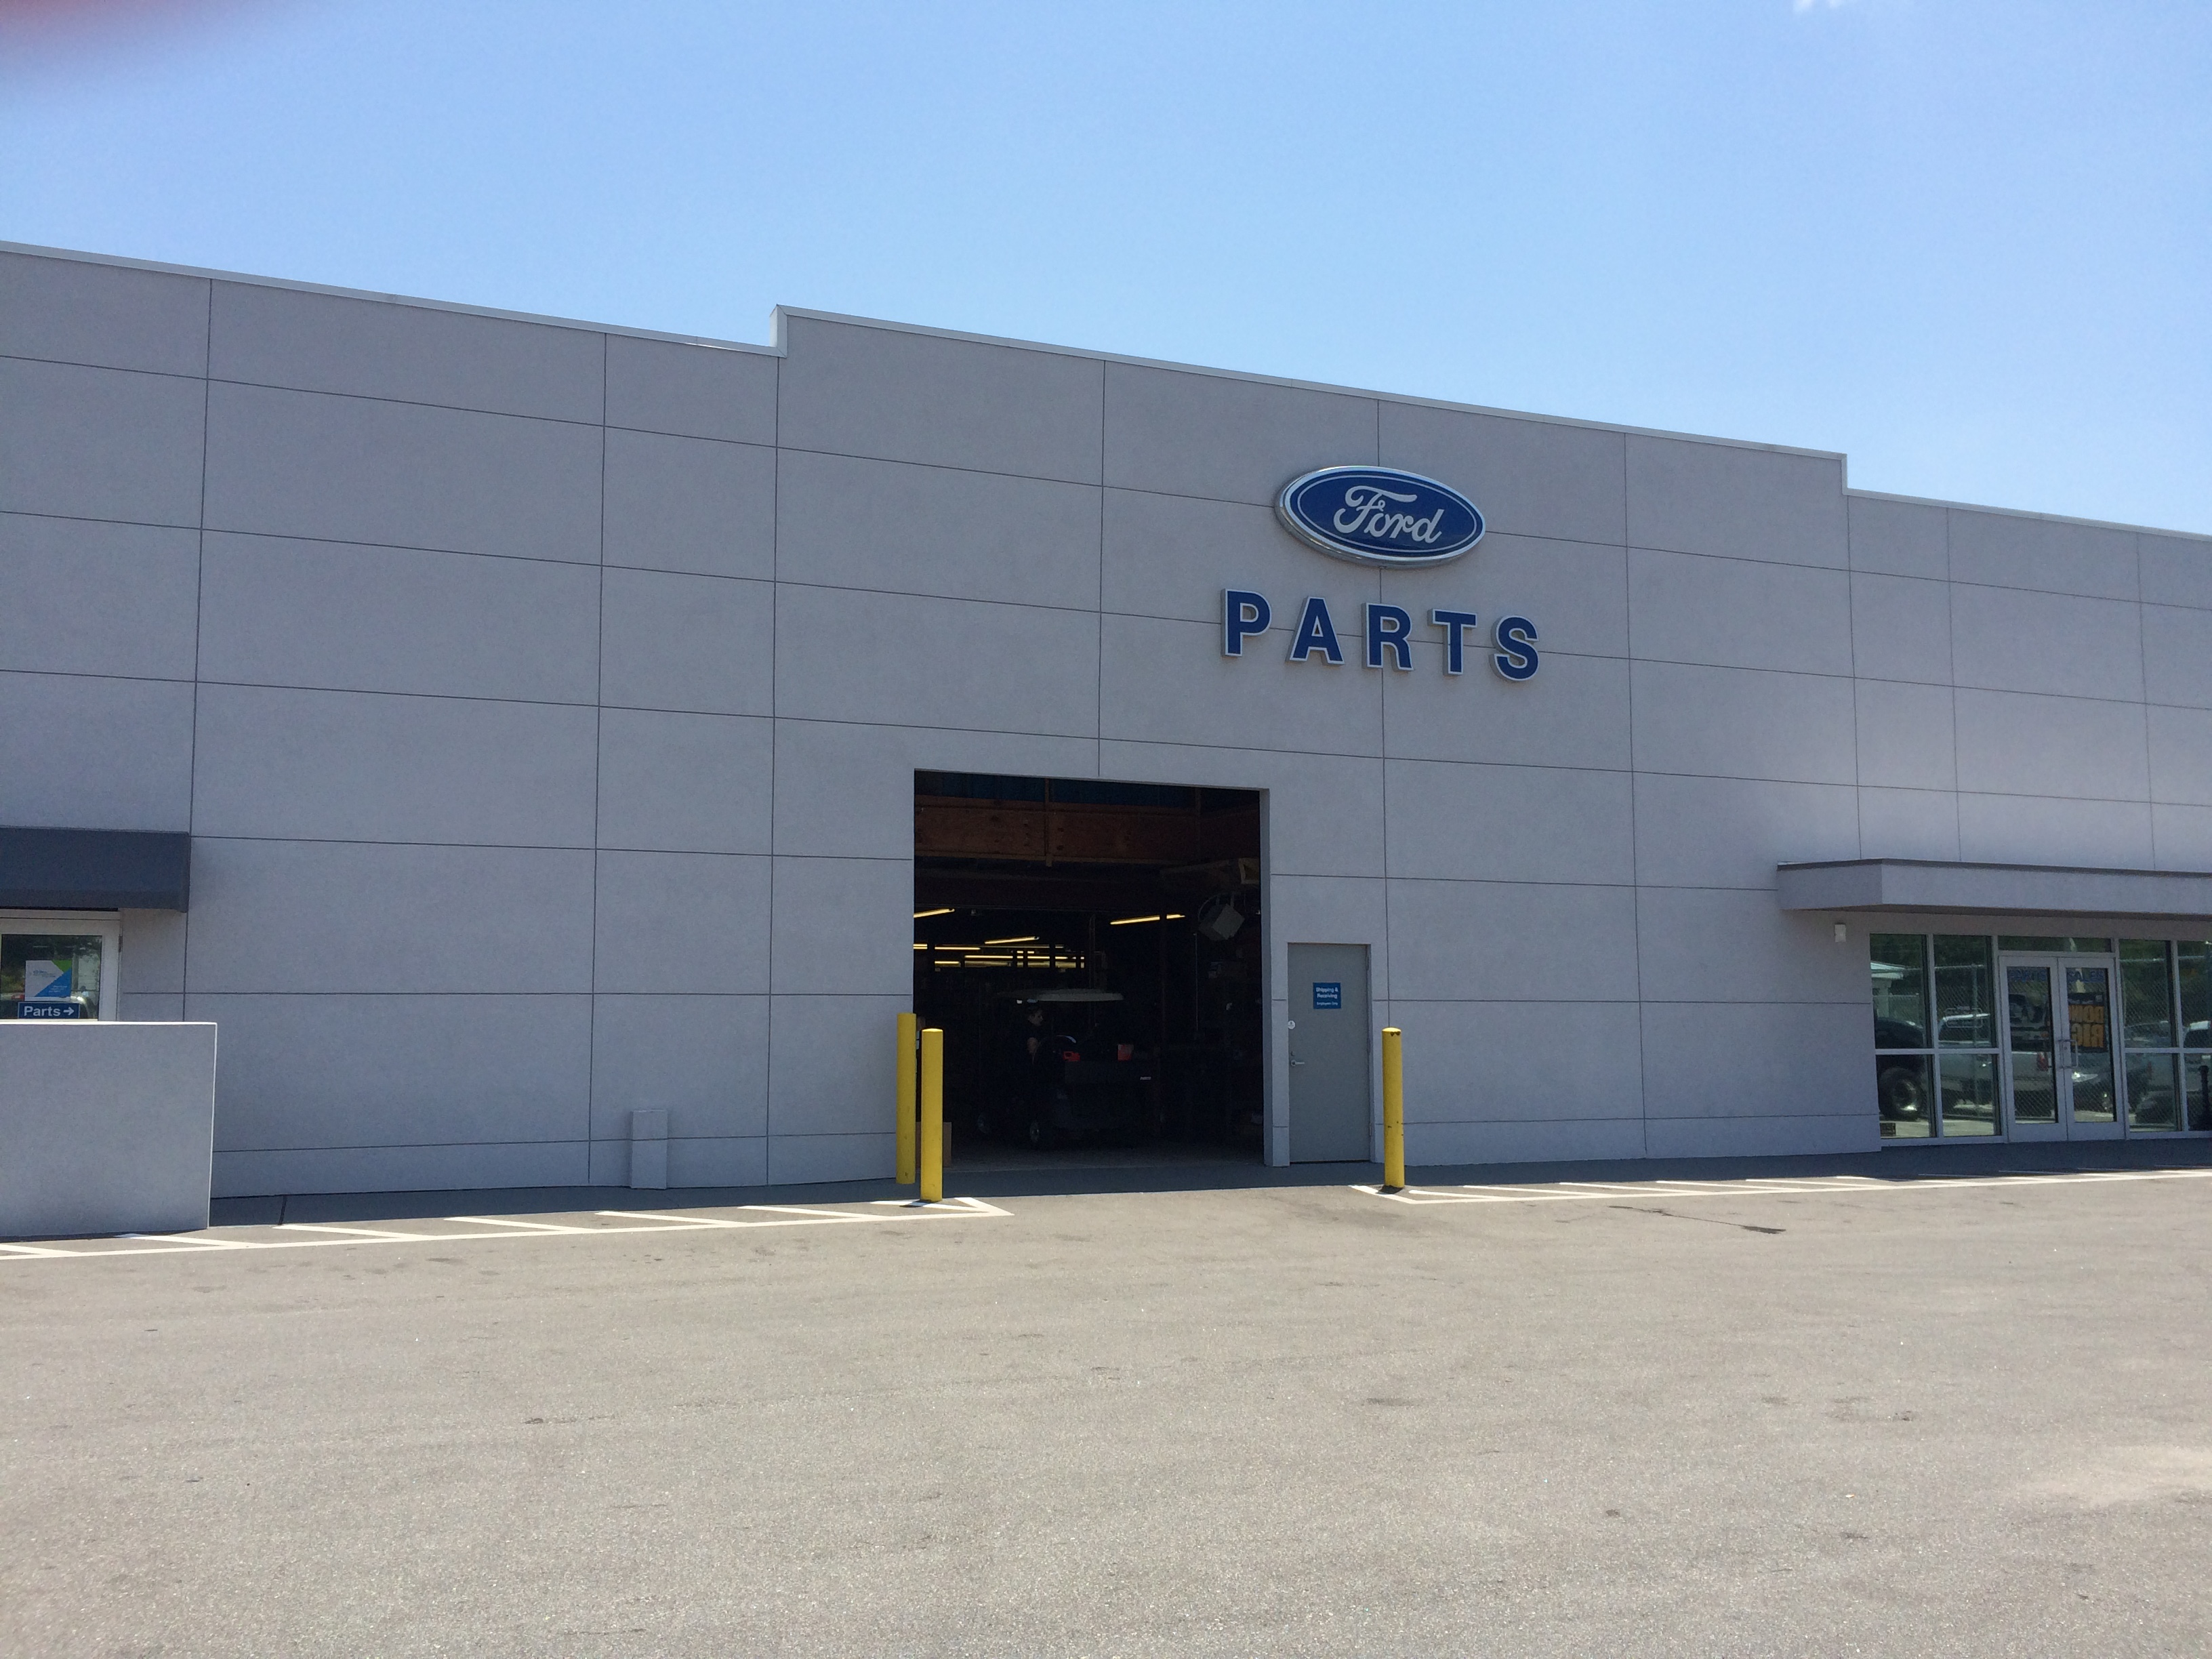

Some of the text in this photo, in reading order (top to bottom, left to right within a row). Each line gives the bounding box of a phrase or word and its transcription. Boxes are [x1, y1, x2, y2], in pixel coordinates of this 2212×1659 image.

[1333, 485, 1444, 544] Ford
[1223, 588, 1540, 681] PARTS
[2009, 970, 2046, 981] PARTS
[2067, 970, 2104, 982] SALES
[24, 1006, 61, 1017] Parts
